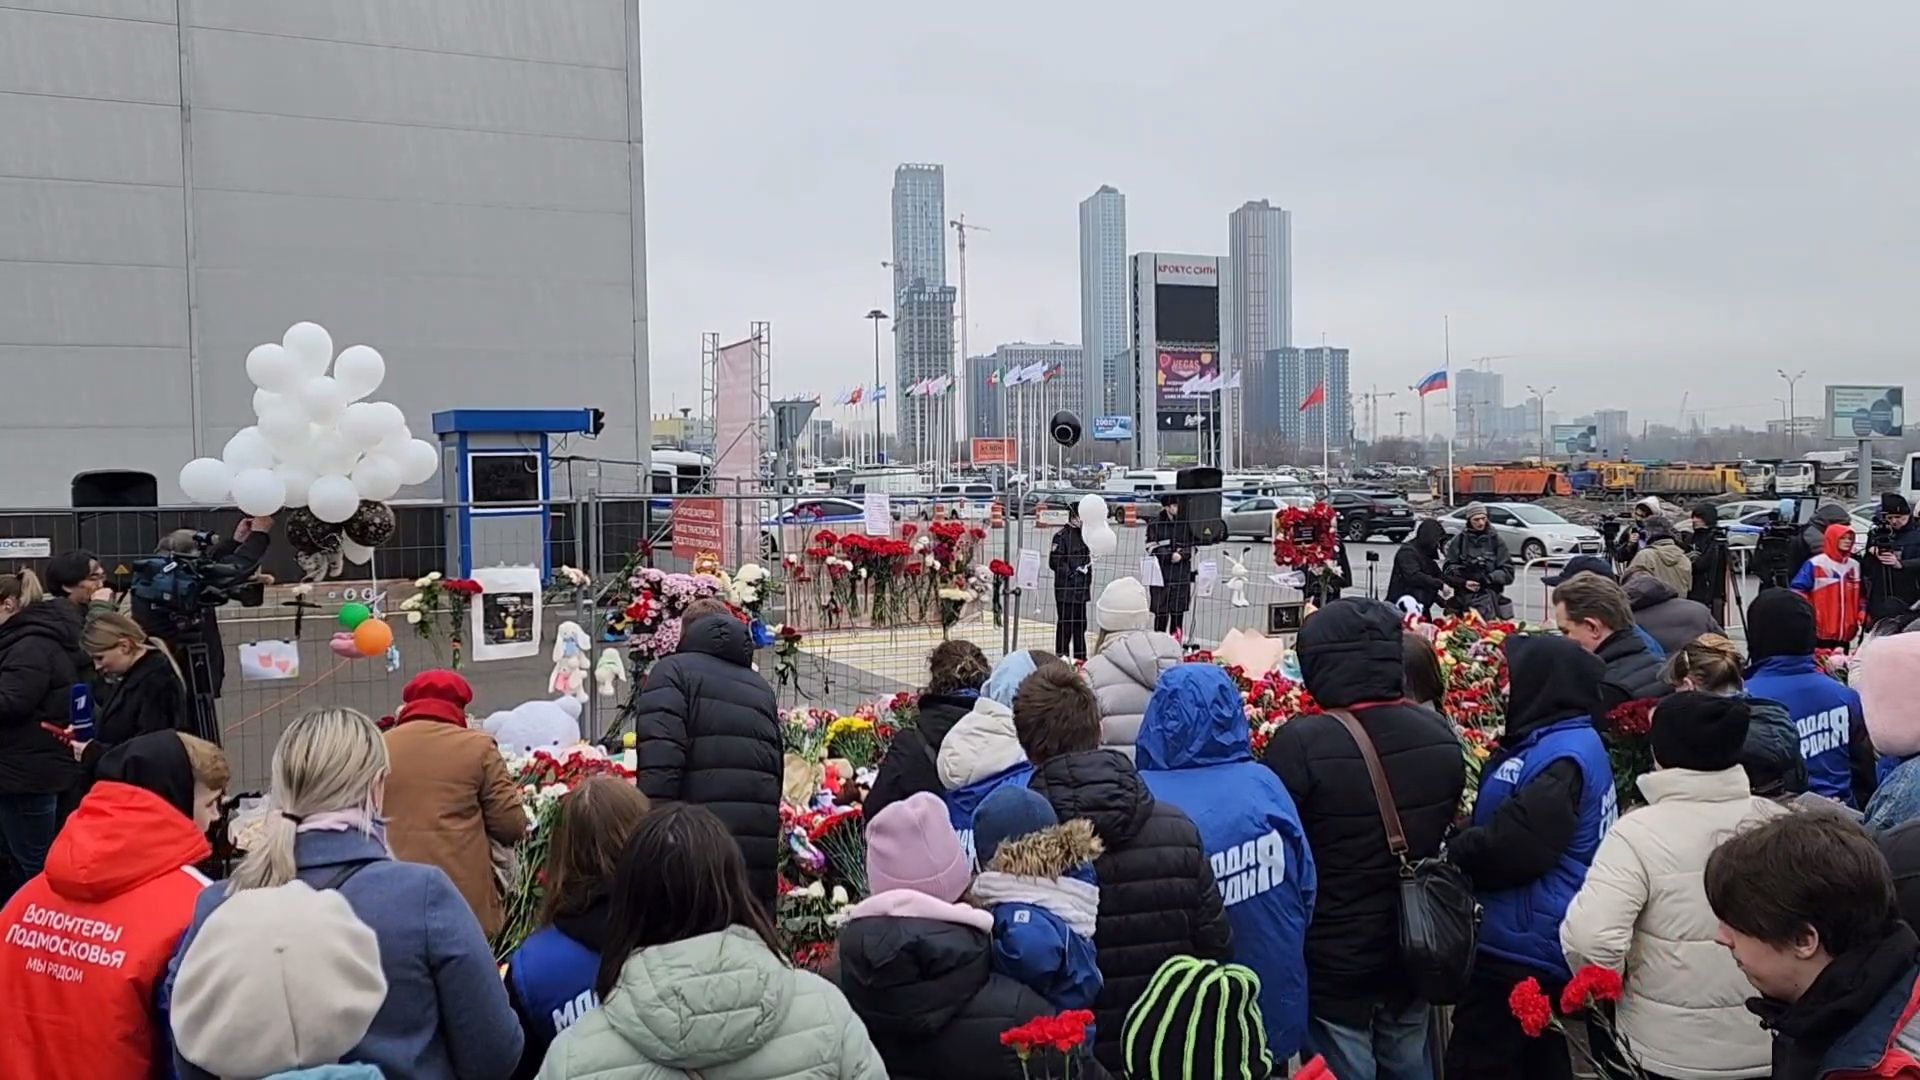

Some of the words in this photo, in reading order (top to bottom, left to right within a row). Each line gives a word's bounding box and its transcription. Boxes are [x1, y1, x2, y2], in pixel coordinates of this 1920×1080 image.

[1158, 264, 1192, 275] КРОКУС
[1193, 265, 1216, 276] СИТИ
[1172, 359, 1200, 369] VEGAS
[23, 904, 122, 943] ВОЛОНТЕРЫ
[5, 924, 125, 968] ПОДМОСКОВЬЯ
[26, 957, 46, 972] МЫ
[47, 962, 83, 983] РЯДОМ
